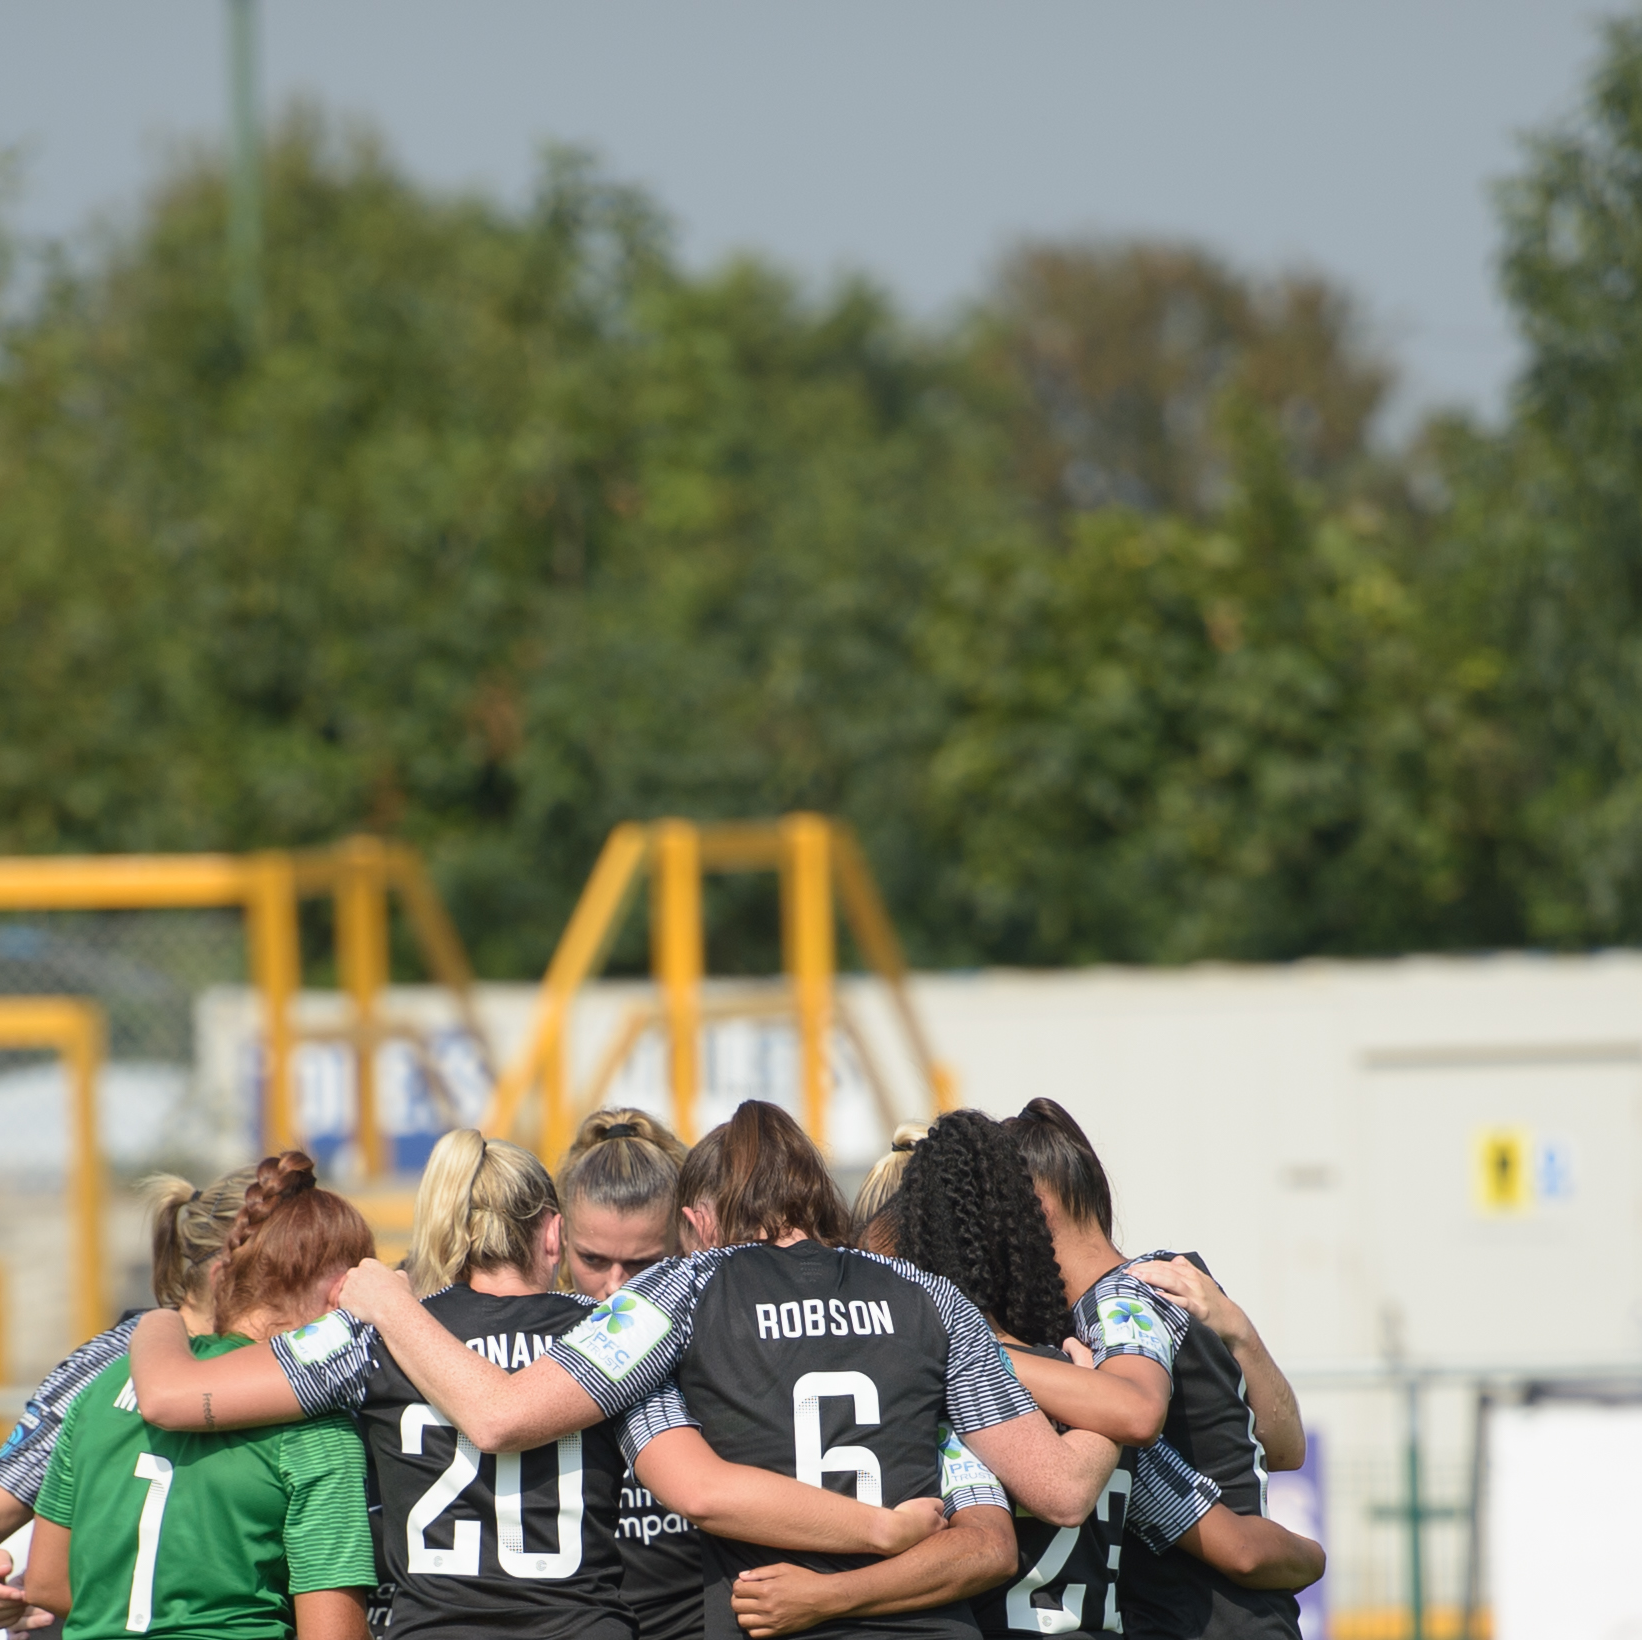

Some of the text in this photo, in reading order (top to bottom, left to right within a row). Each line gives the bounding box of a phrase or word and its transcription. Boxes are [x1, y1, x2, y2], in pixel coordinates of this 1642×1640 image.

[755, 1298, 895, 1340] ROBSON
[465, 1331, 554, 1369] ONAN
[586, 1341, 621, 1372] TRUST
[593, 1332, 630, 1366] PFC
[202, 1392, 216, 1431] Freedo
[793, 1370, 883, 1506] 6
[399, 1403, 584, 1579] 20
[951, 1472, 993, 1483] TRUST
[124, 1452, 174, 1633] 1
